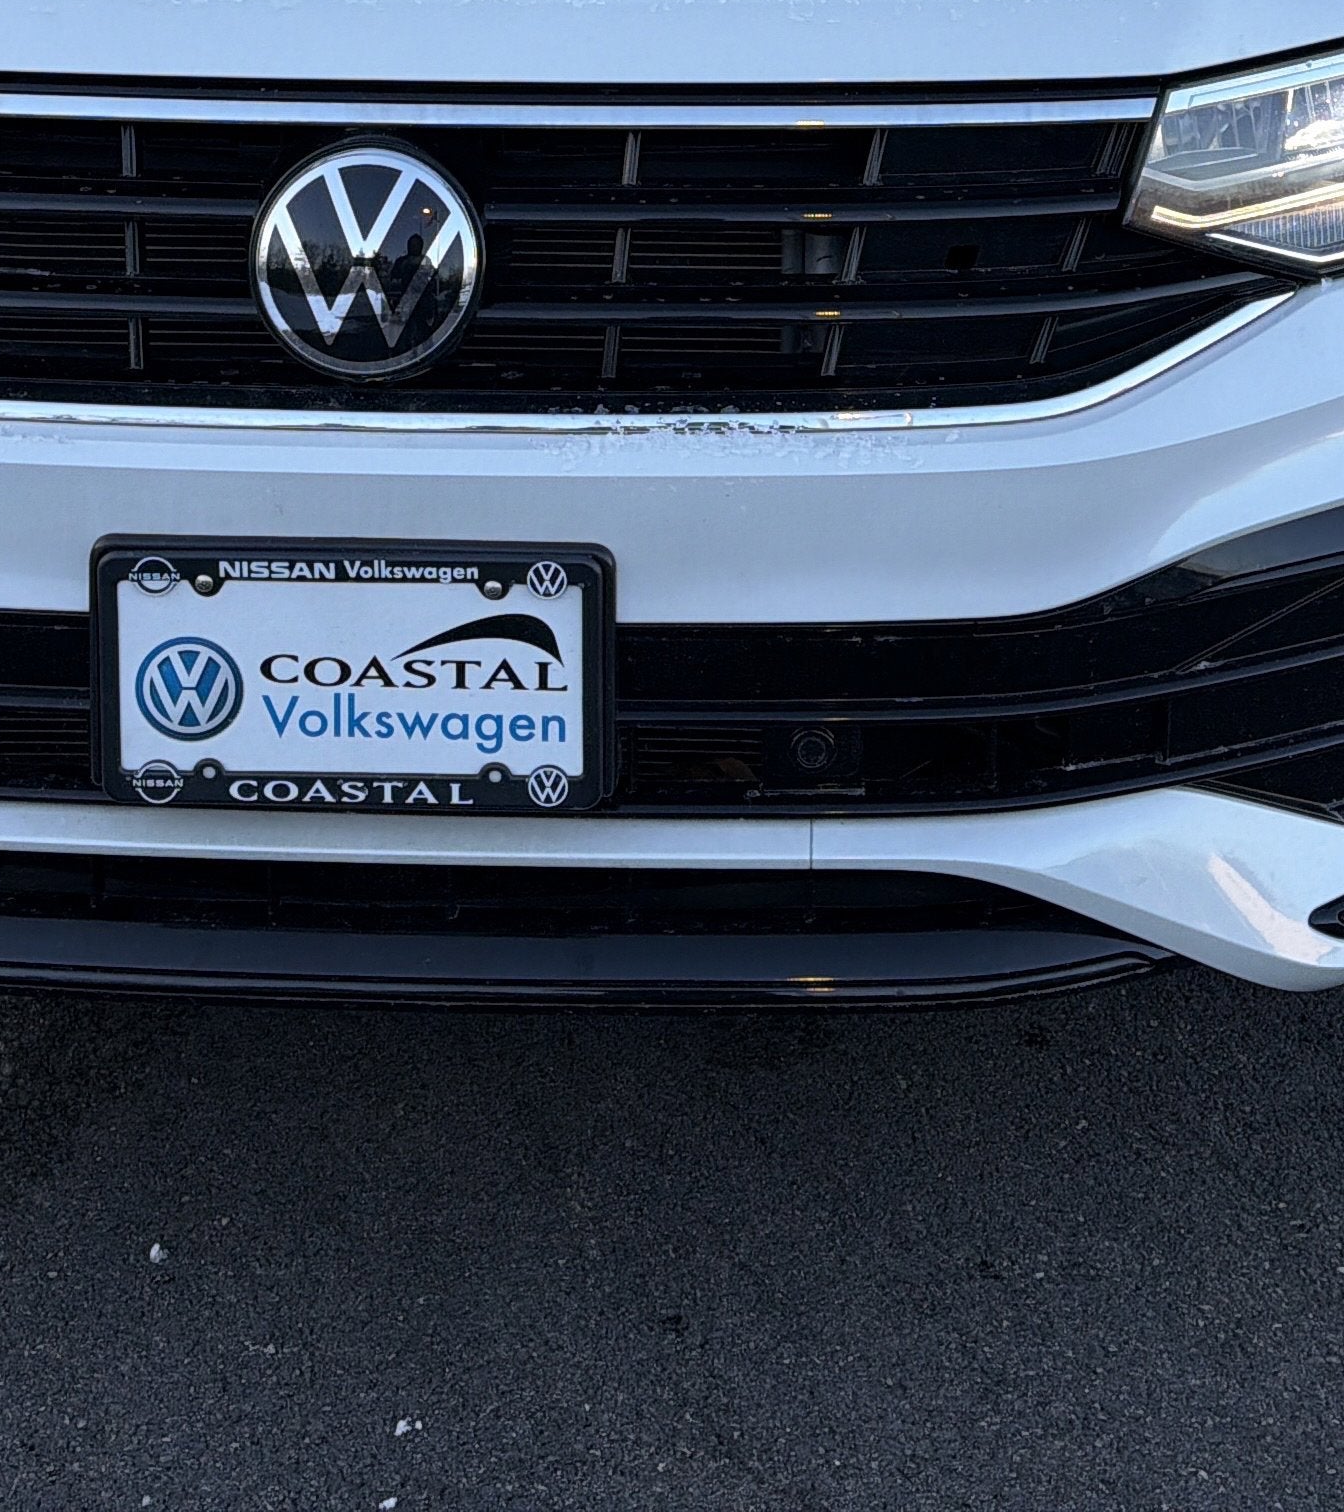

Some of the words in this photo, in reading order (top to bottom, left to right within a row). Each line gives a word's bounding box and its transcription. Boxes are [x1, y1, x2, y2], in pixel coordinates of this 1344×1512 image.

[128, 571, 181, 581] NISSAN
[218, 560, 337, 580] NISSAN
[343, 559, 480, 584] Volkswagen
[259, 653, 568, 692] COASTAL
[140, 641, 239, 737] VW
[261, 692, 567, 754] Volkswagen
[132, 778, 184, 788] NISSAN
[228, 779, 475, 806] COASTAL
